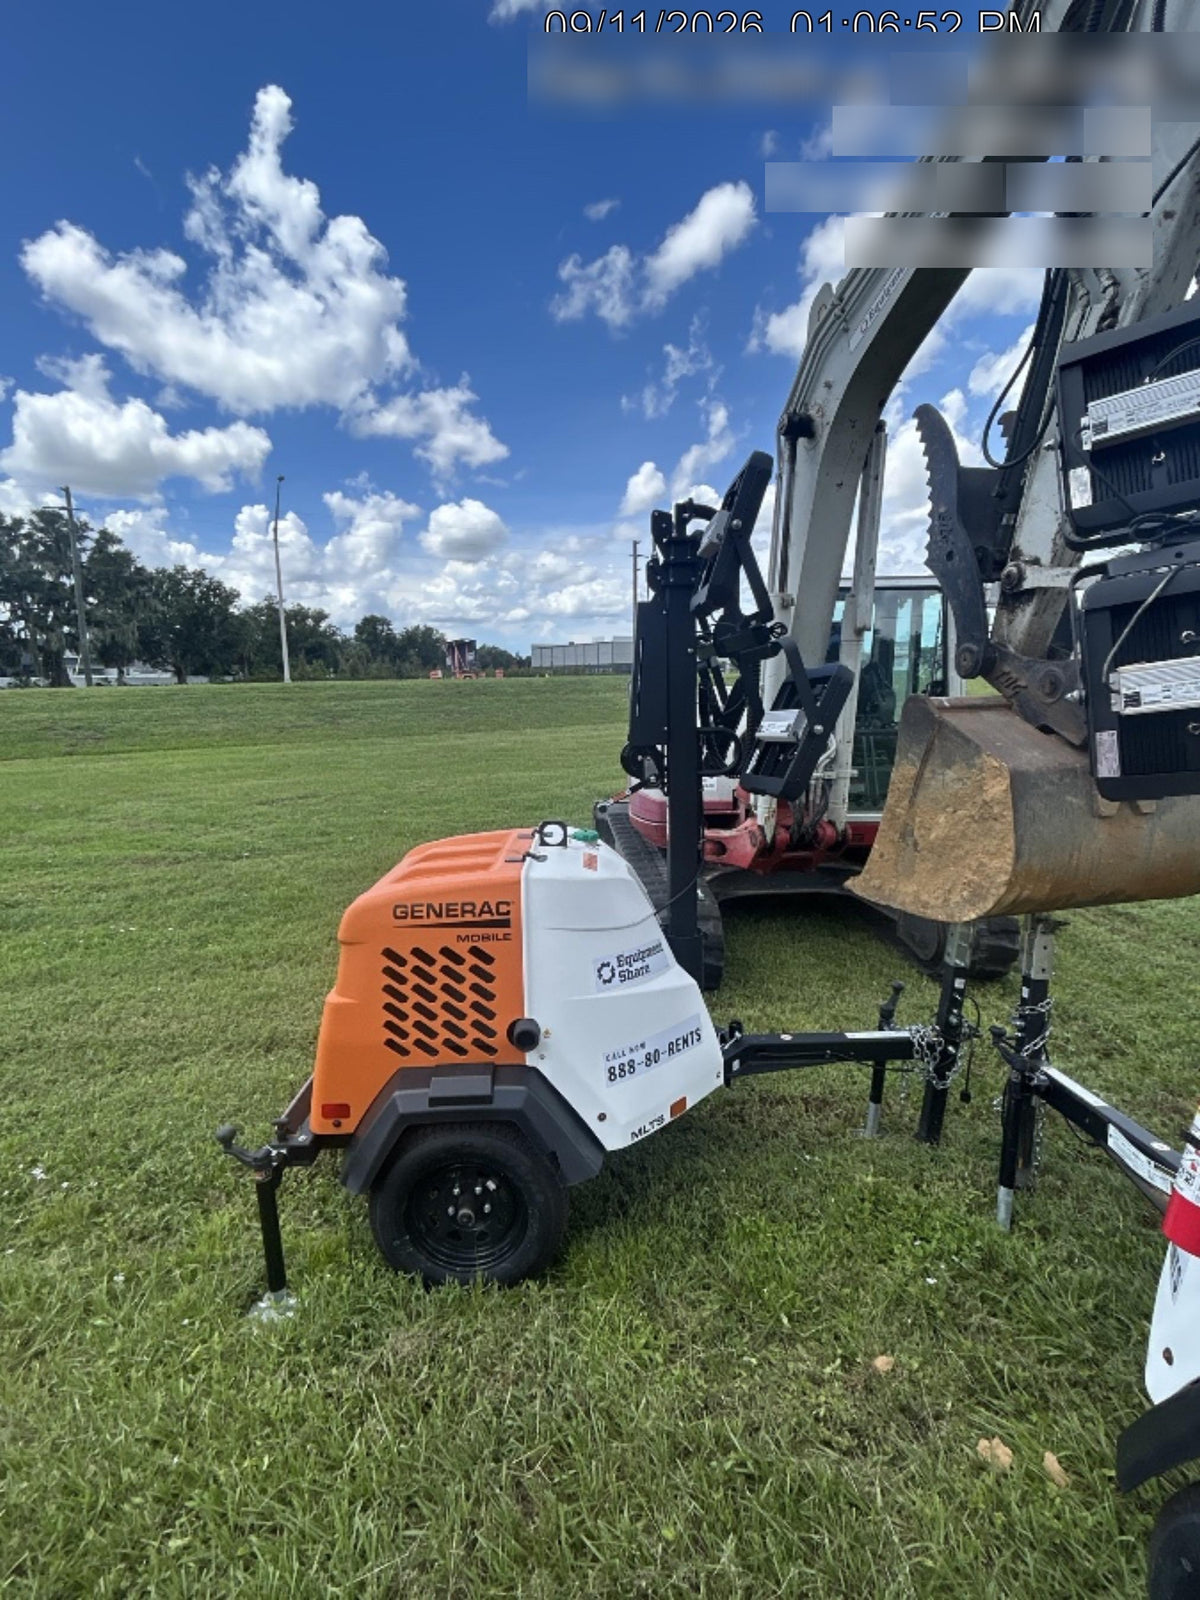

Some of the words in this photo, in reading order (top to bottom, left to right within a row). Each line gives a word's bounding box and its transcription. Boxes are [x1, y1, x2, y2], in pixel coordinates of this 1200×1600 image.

[393, 900, 511, 920] GENERAC
[456, 933, 512, 943] MOBILE
[618, 964, 651, 983] Share
[607, 1027, 702, 1082] 888-80-RENTS
